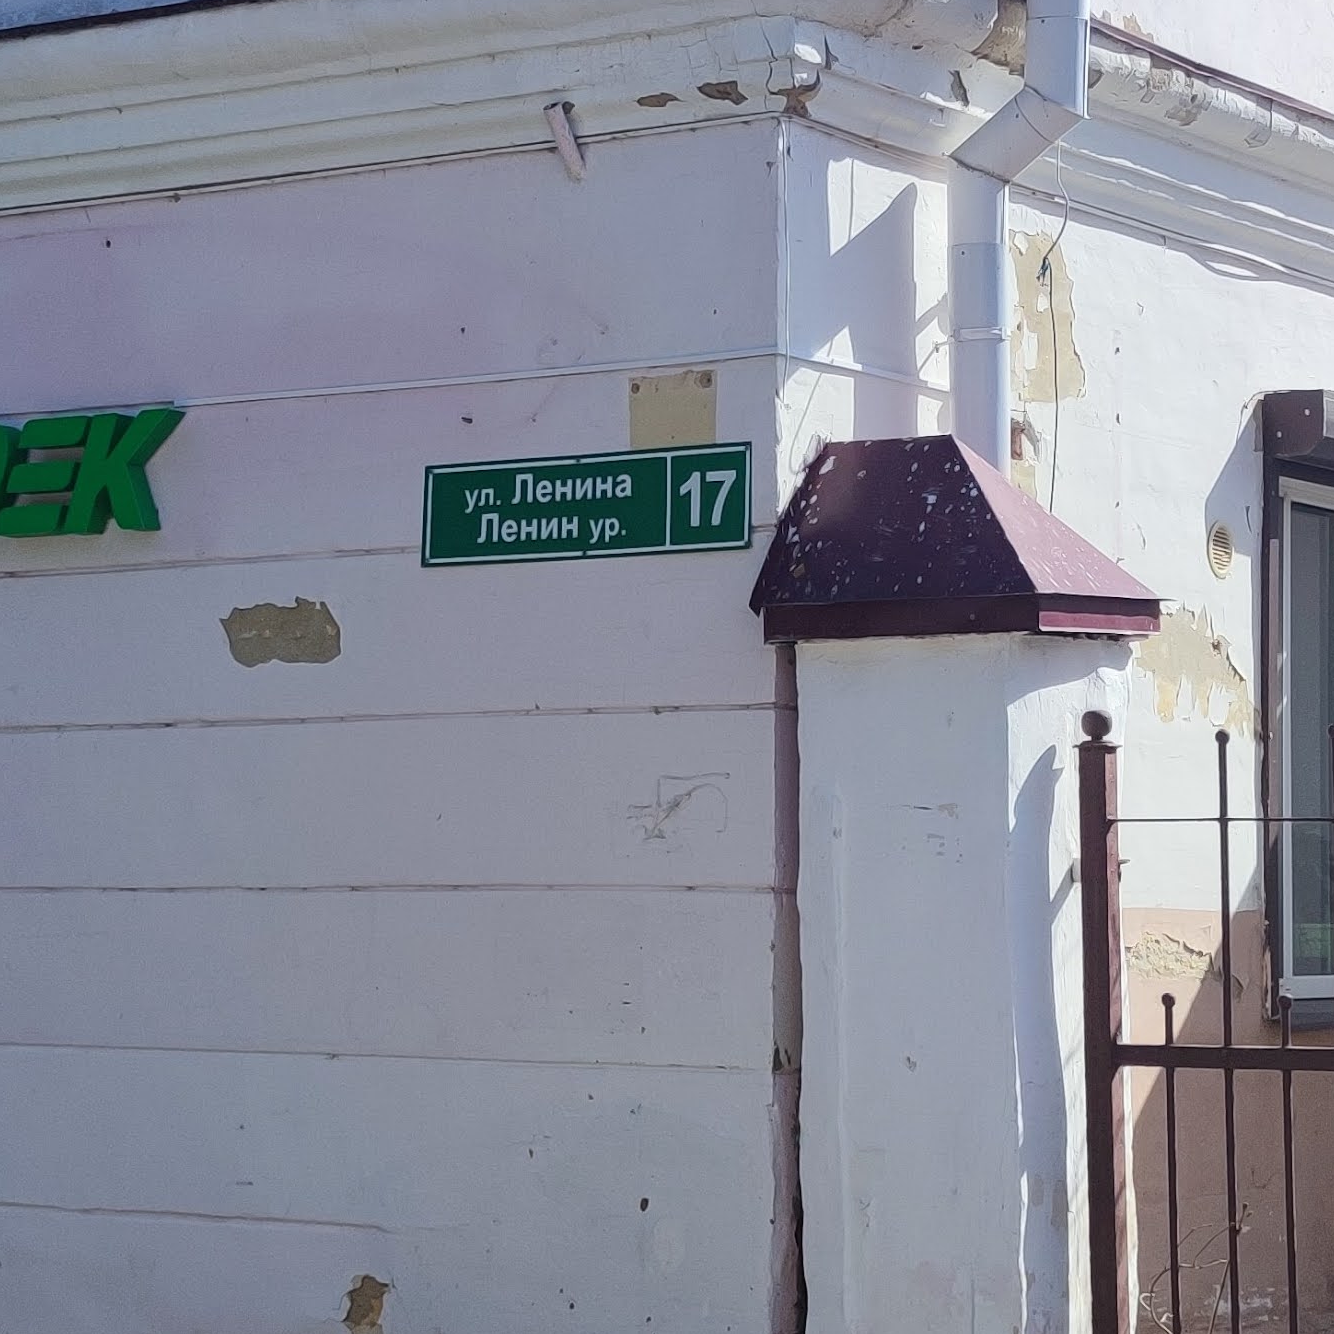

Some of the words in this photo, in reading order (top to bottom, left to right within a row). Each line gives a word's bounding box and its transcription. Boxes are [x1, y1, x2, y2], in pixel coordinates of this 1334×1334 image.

[463, 486, 501, 513] ул.
[511, 472, 633, 505] Ленина
[678, 469, 737, 528] 17
[476, 513, 579, 544] Ленин
[588, 517, 627, 544] ур.
